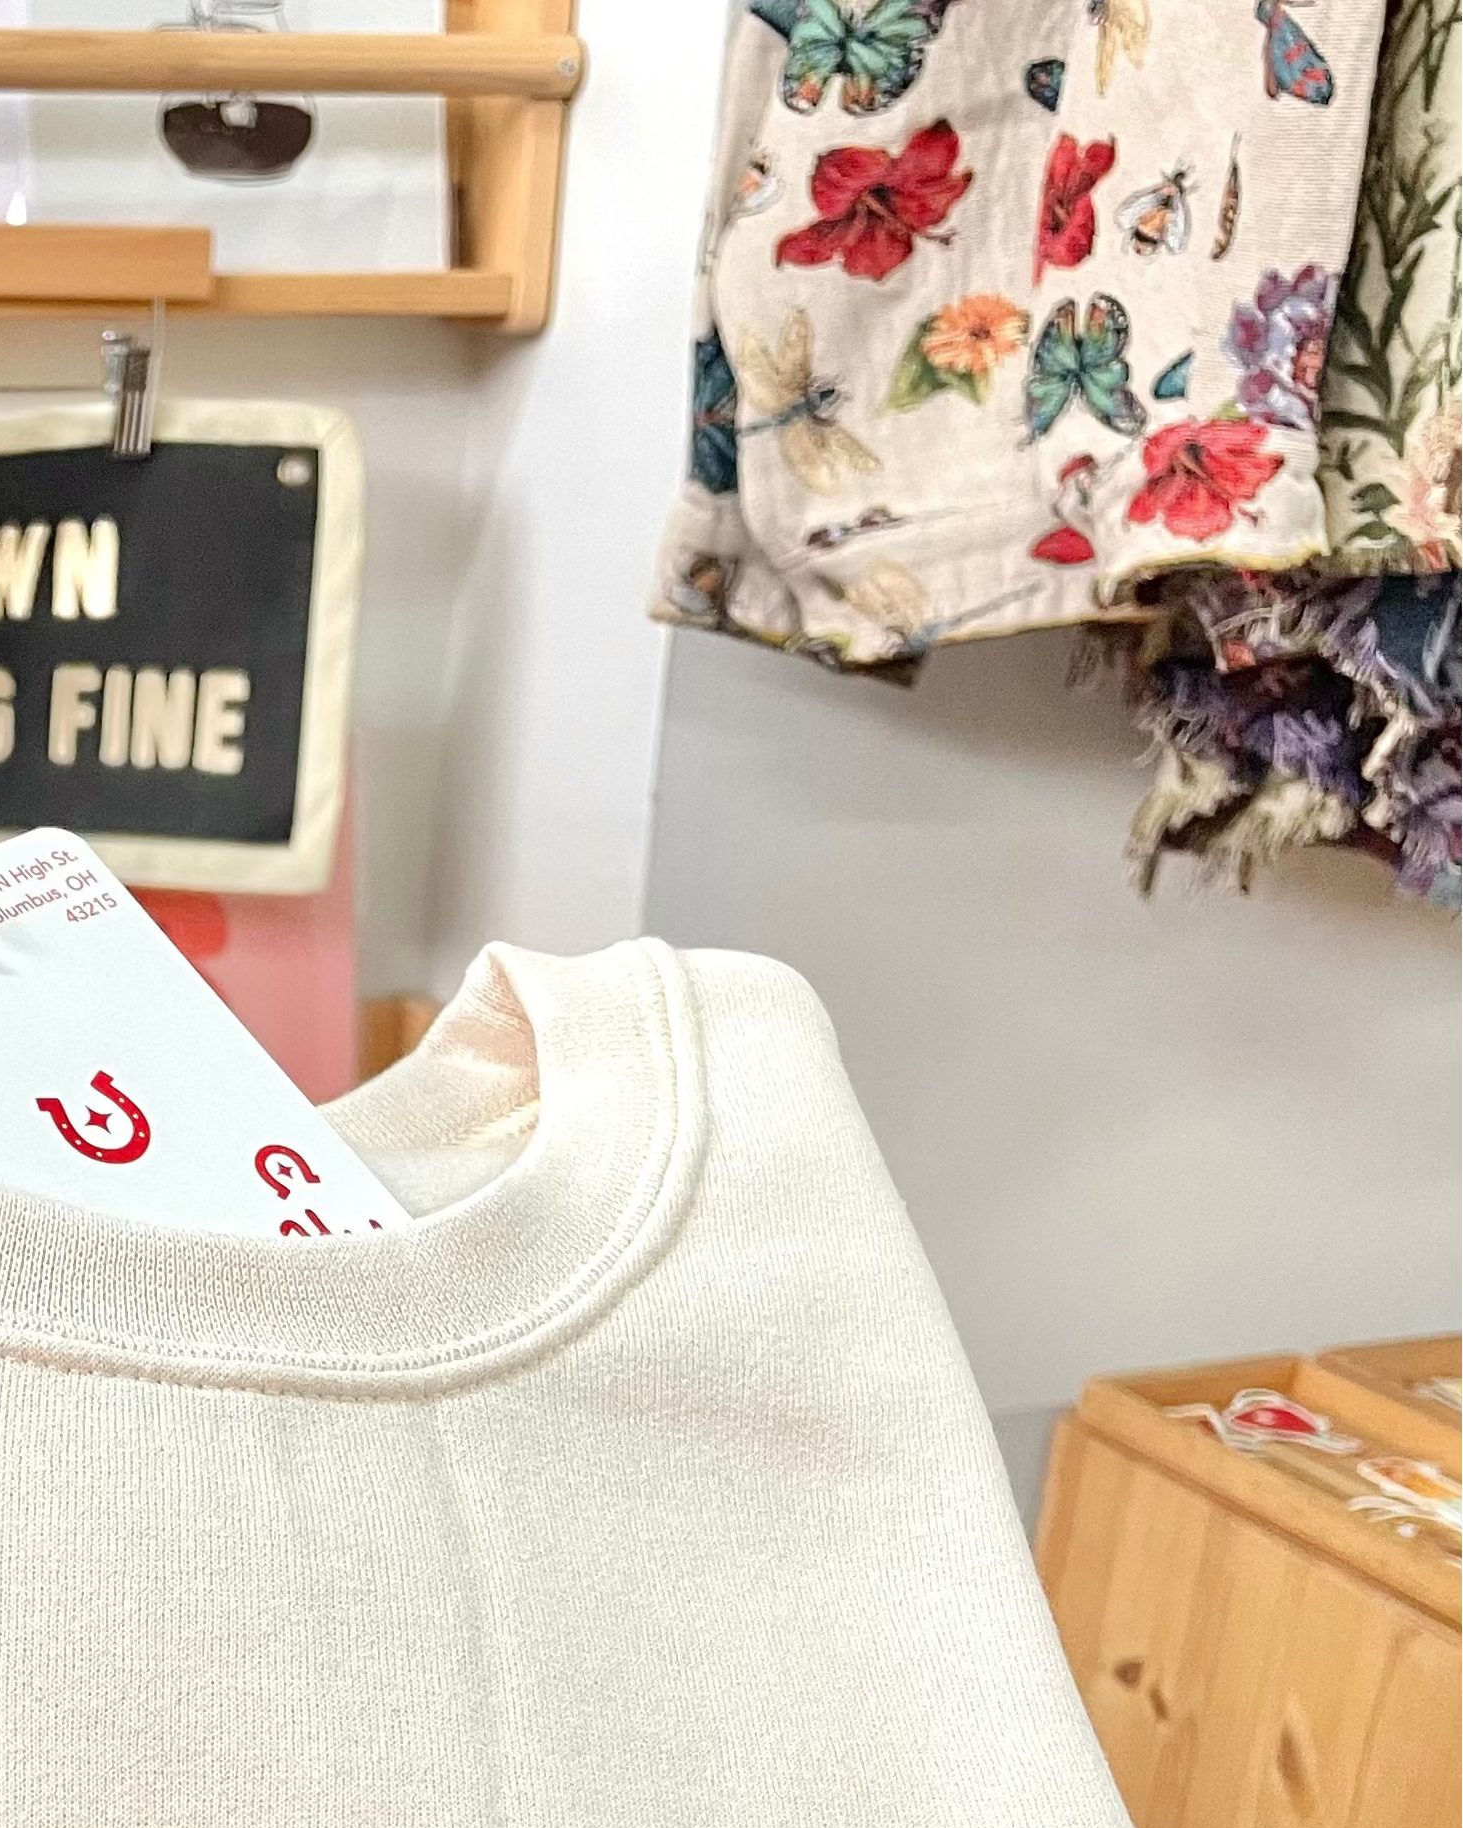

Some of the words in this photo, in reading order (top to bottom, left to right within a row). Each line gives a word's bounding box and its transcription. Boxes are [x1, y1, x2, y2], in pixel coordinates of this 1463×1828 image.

[47, 664, 251, 776] FINE
[8, 858, 54, 885] High
[64, 869, 99, 892] OH
[65, 892, 118, 924] 43215
